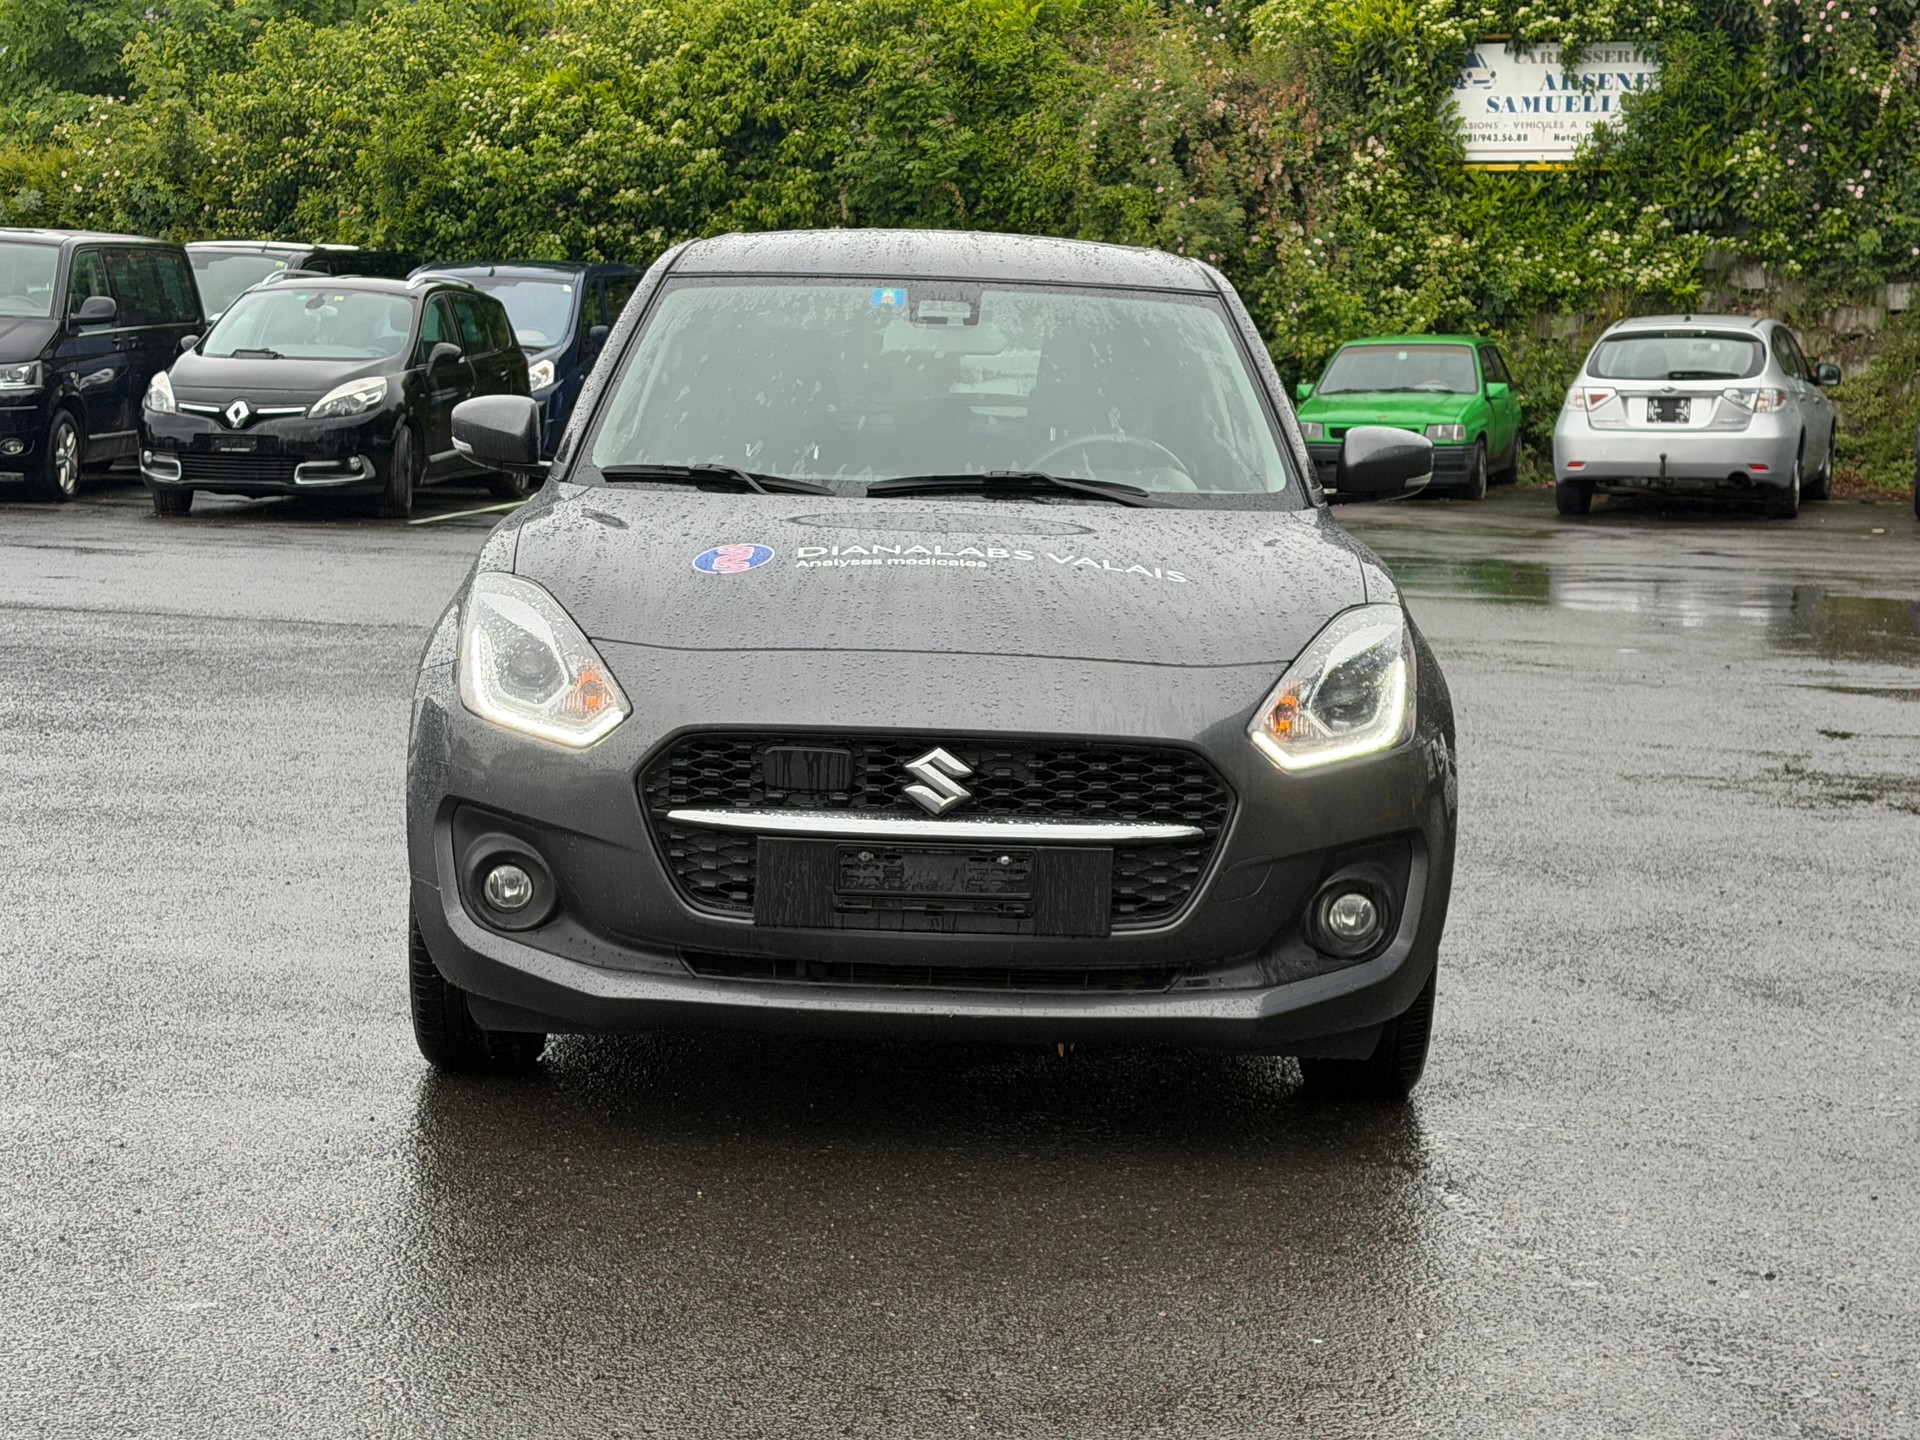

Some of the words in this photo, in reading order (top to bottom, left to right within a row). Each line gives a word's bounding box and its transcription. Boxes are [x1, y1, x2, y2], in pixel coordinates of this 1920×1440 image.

[1460, 121, 1499, 130] ASIONS
[798, 545, 1035, 561] DIANALABS
[1046, 552, 1187, 582] VALAIS
